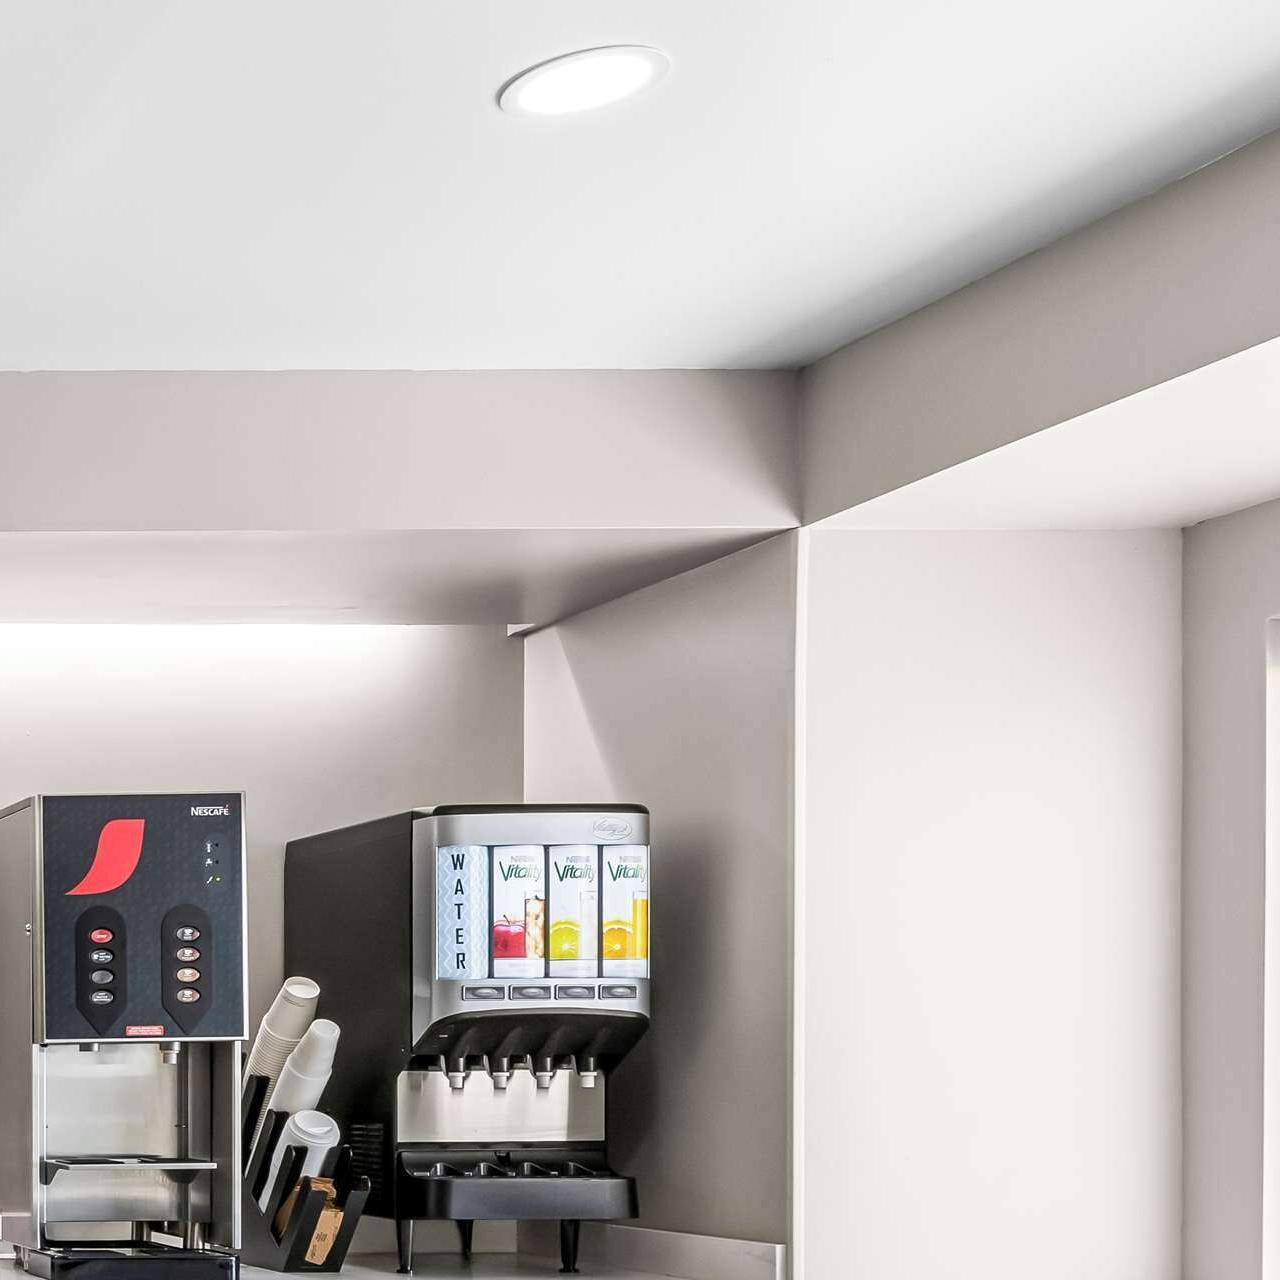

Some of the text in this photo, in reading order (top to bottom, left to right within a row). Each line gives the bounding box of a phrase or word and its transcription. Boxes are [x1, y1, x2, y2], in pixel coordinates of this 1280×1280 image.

[499, 861, 541, 882] Vitality
[554, 861, 596, 882] Vitality
[608, 861, 647, 882] Vitality
[450, 853, 466, 970] WATER
